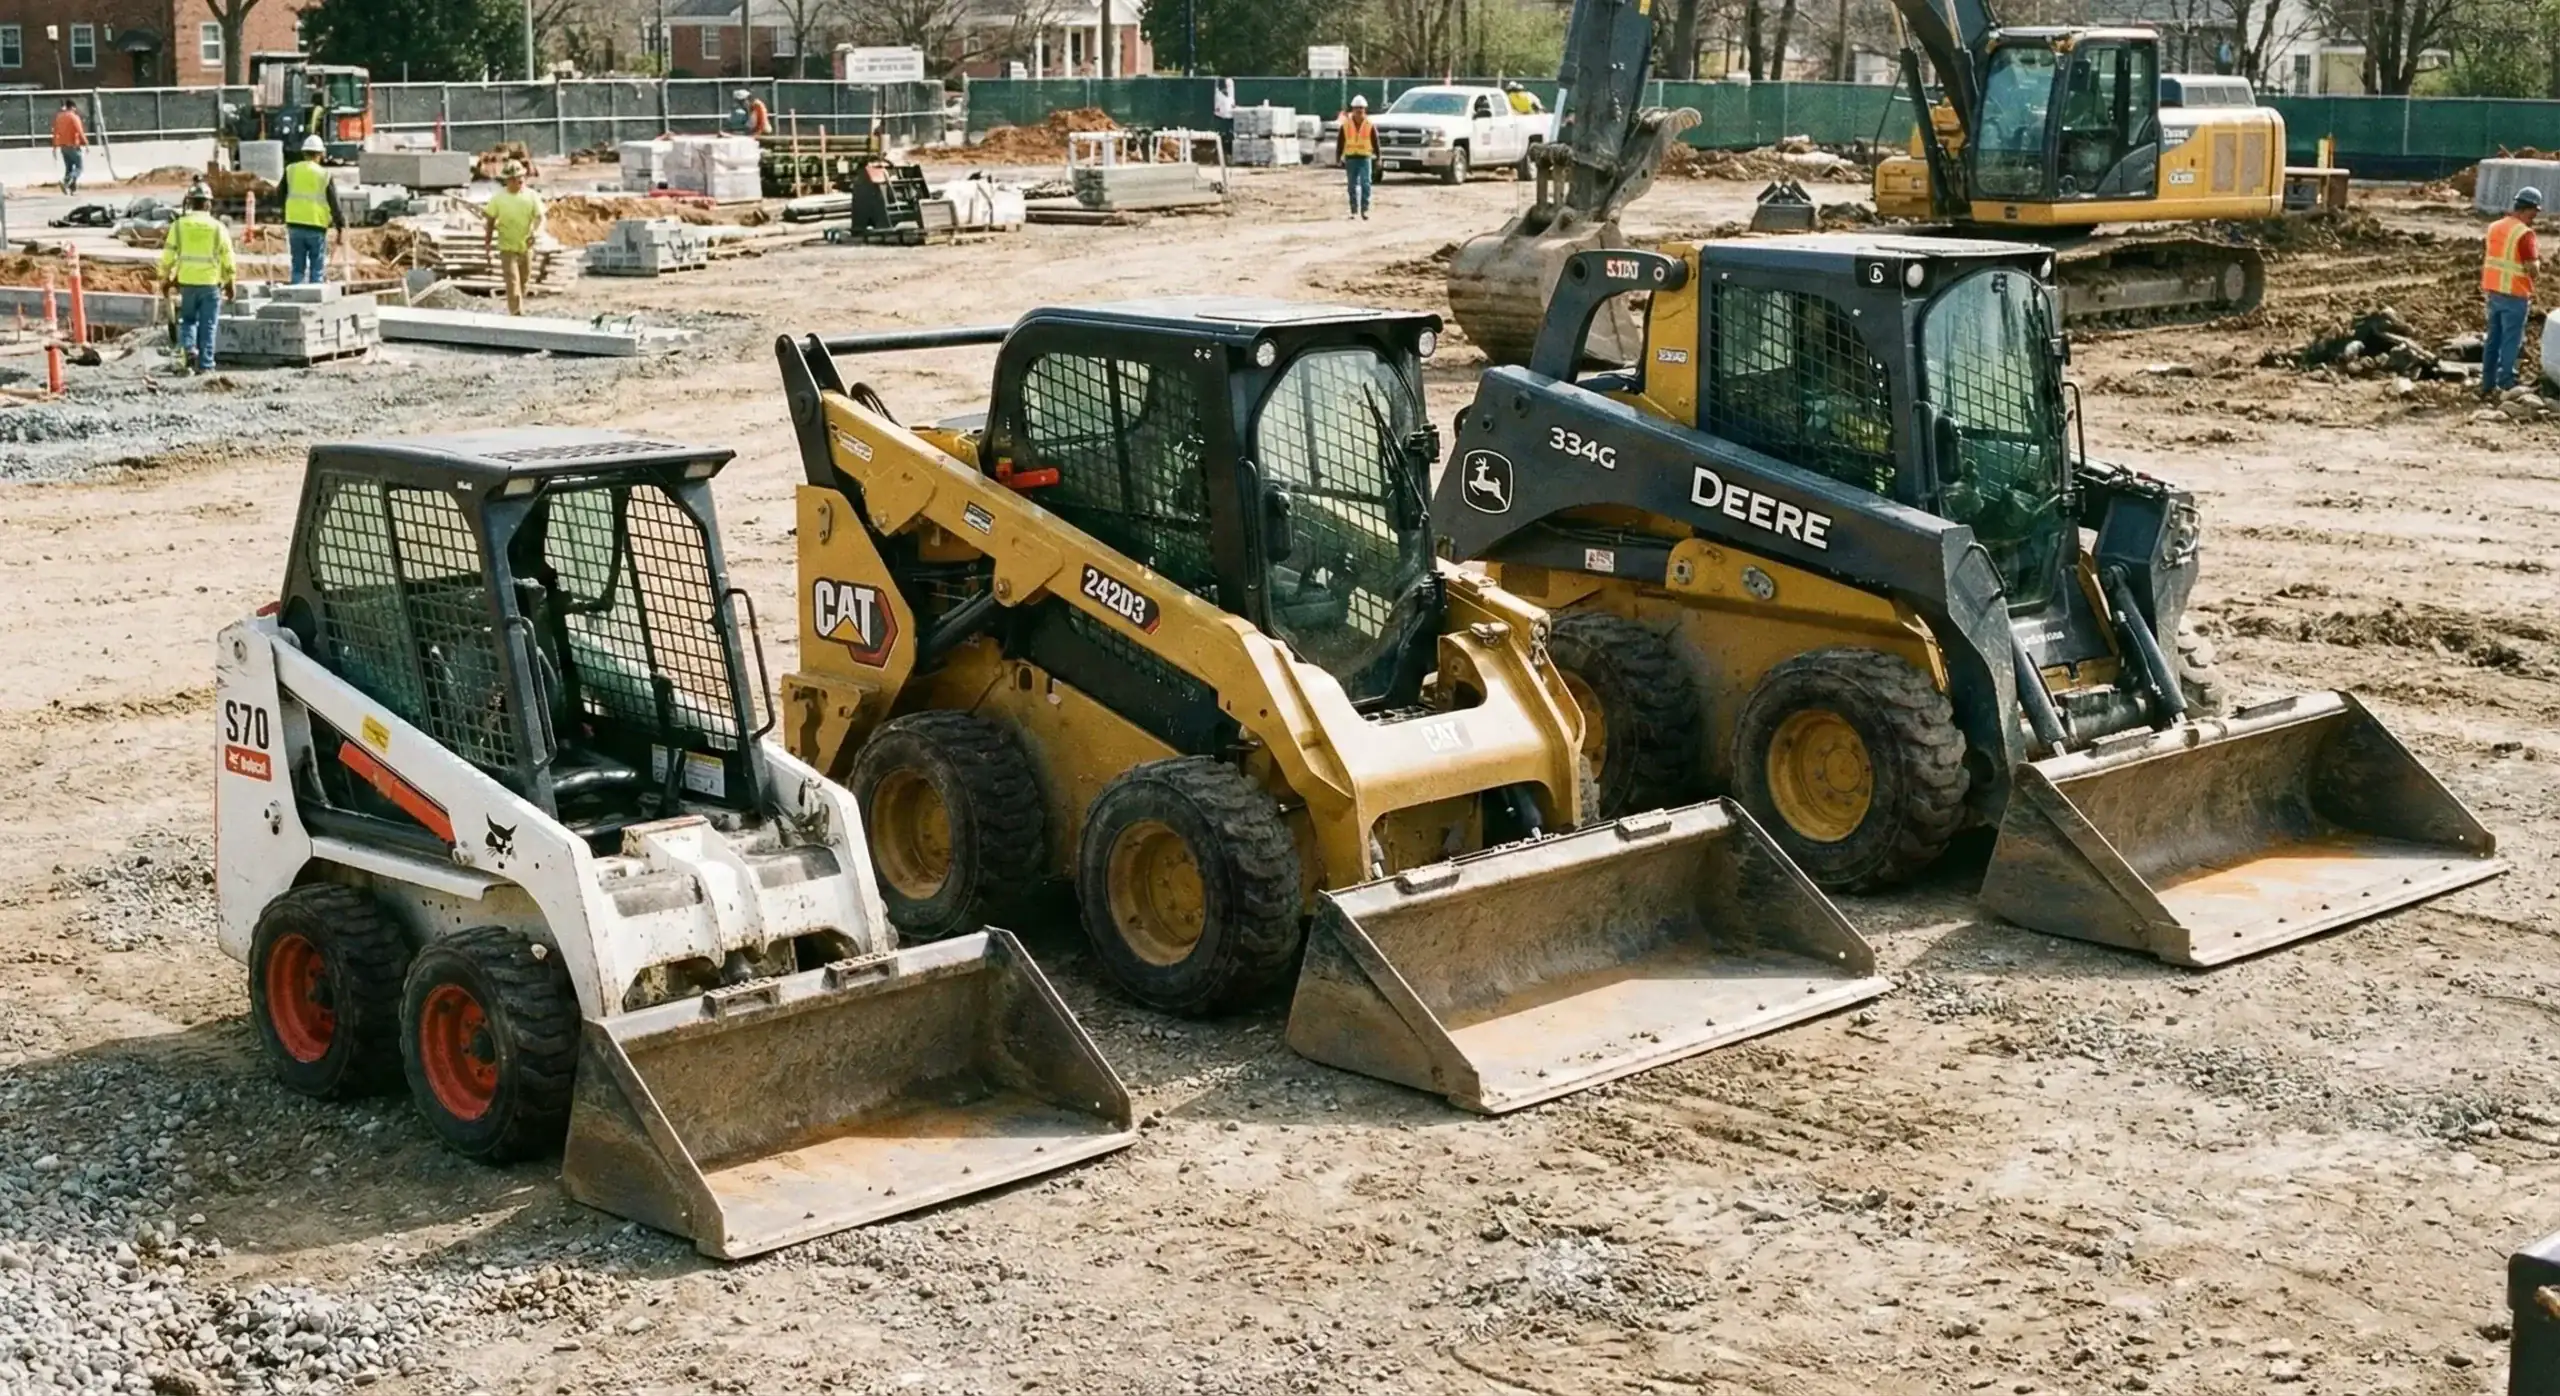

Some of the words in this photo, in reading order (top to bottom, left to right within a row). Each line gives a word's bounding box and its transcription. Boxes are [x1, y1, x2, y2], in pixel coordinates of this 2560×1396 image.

[1549, 426, 1617, 470] 334G
[1691, 466, 1831, 550] DEERE
[815, 580, 876, 648] CAT
[1084, 568, 1146, 624] 242D3
[225, 699, 269, 750] S70
[1421, 720, 1465, 752] CAT
